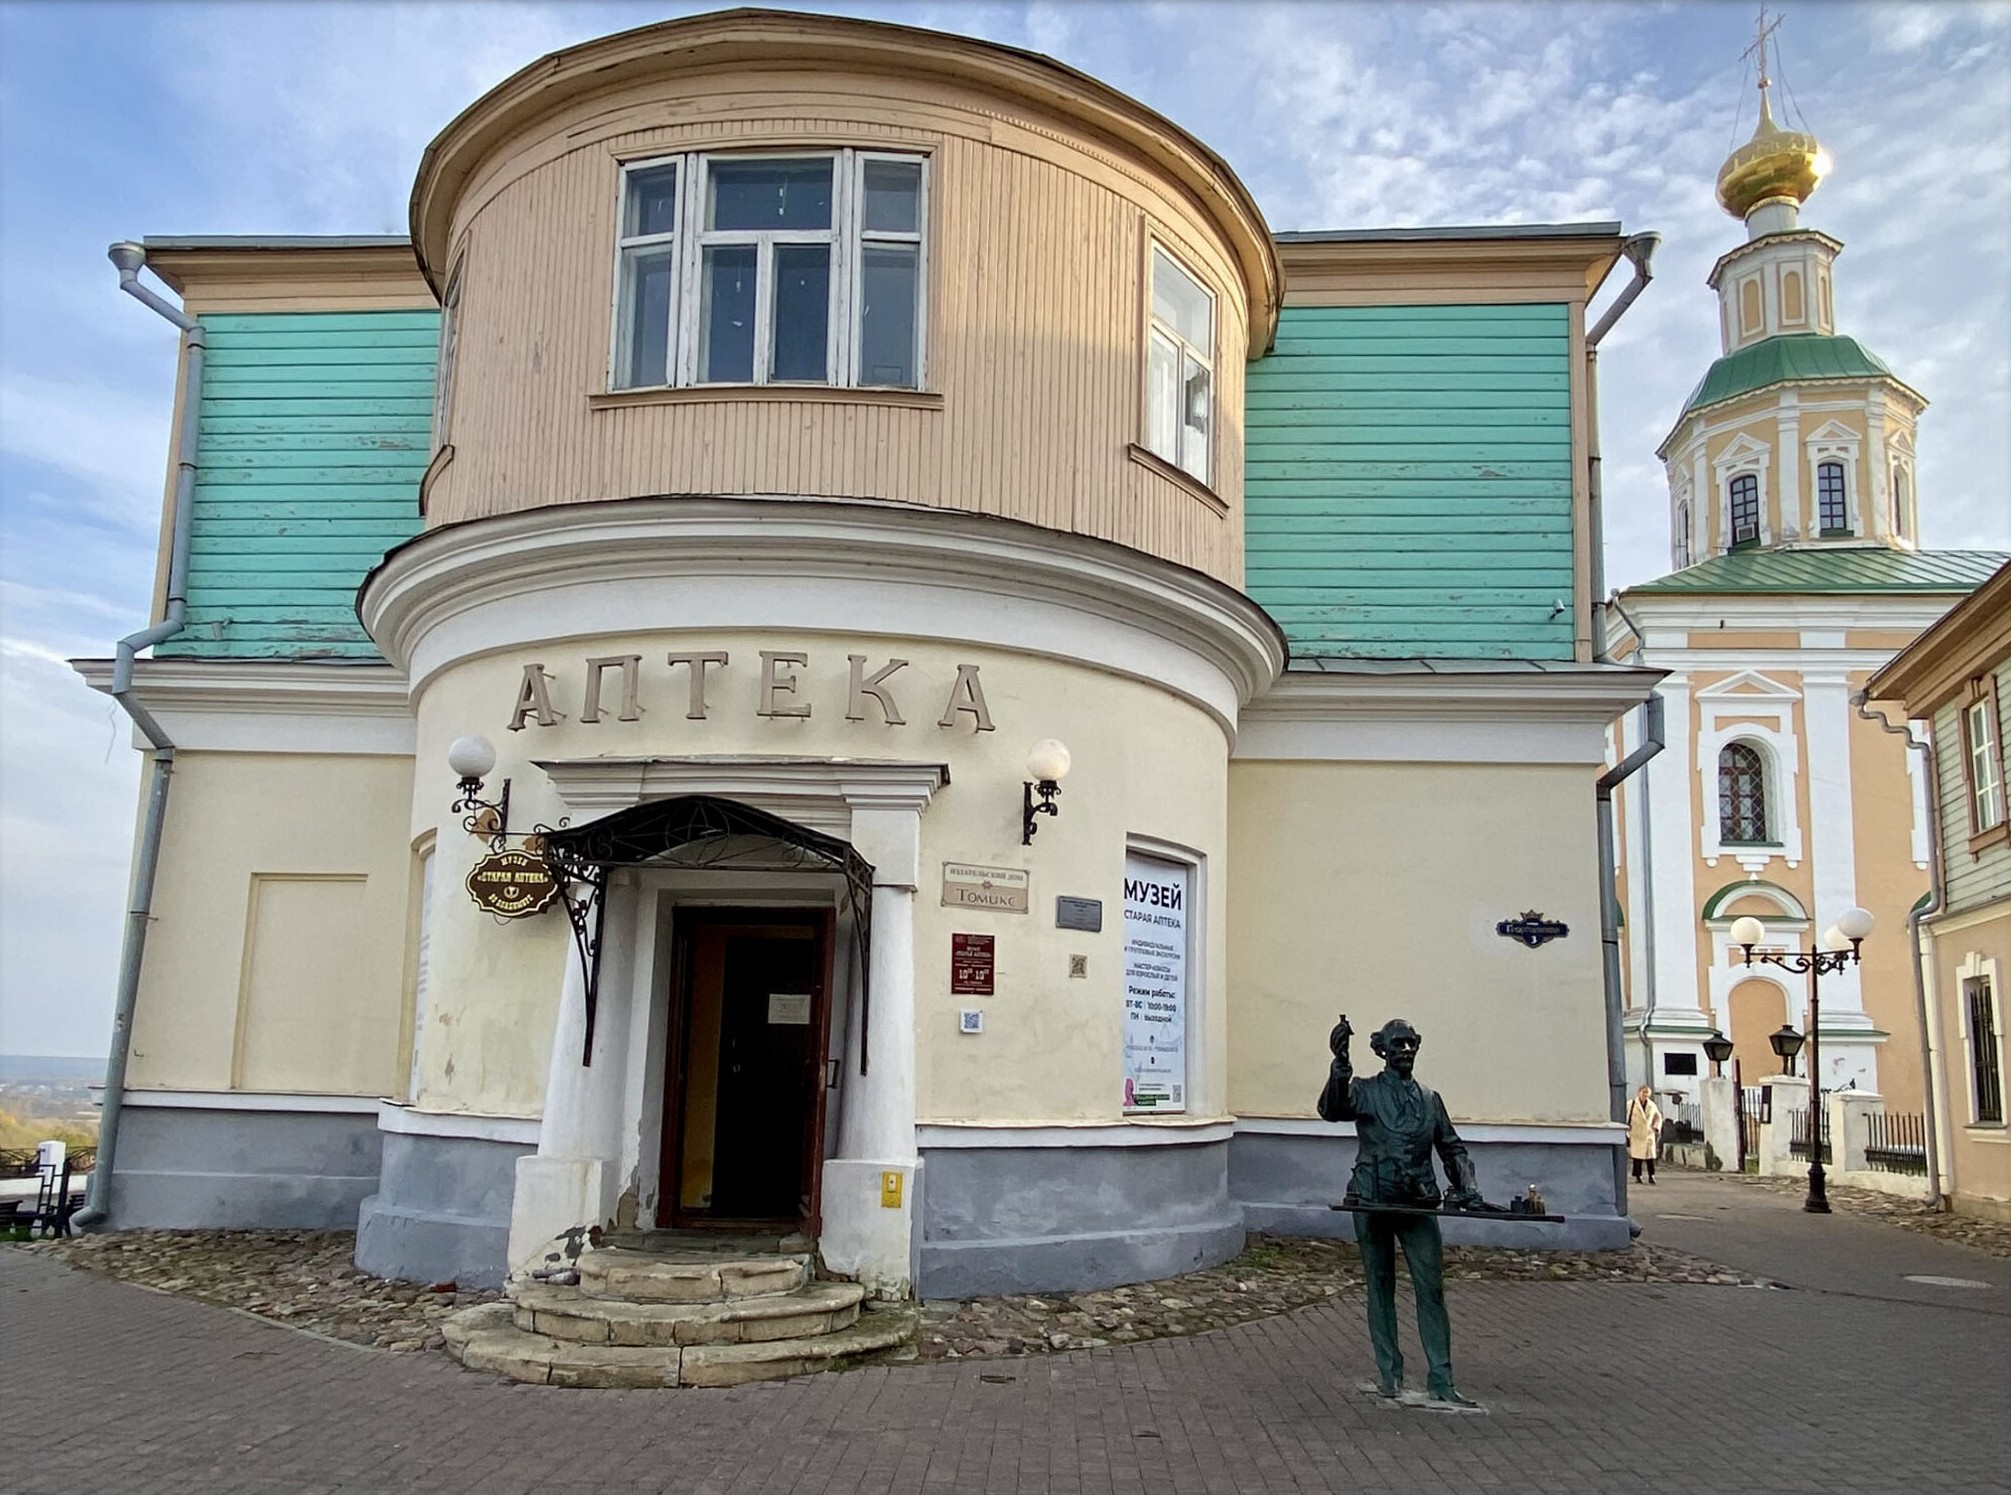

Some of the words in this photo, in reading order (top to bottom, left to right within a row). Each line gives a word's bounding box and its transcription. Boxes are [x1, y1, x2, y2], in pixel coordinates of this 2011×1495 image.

[506, 650, 996, 732] АПТЕКА
[1124, 877, 1181, 911] МУЗЕЙ
[1124, 909, 1152, 923] СТАРАЯ
[1153, 915, 1181, 929] АПТЕКА
[1129, 985, 1150, 996] Режим
